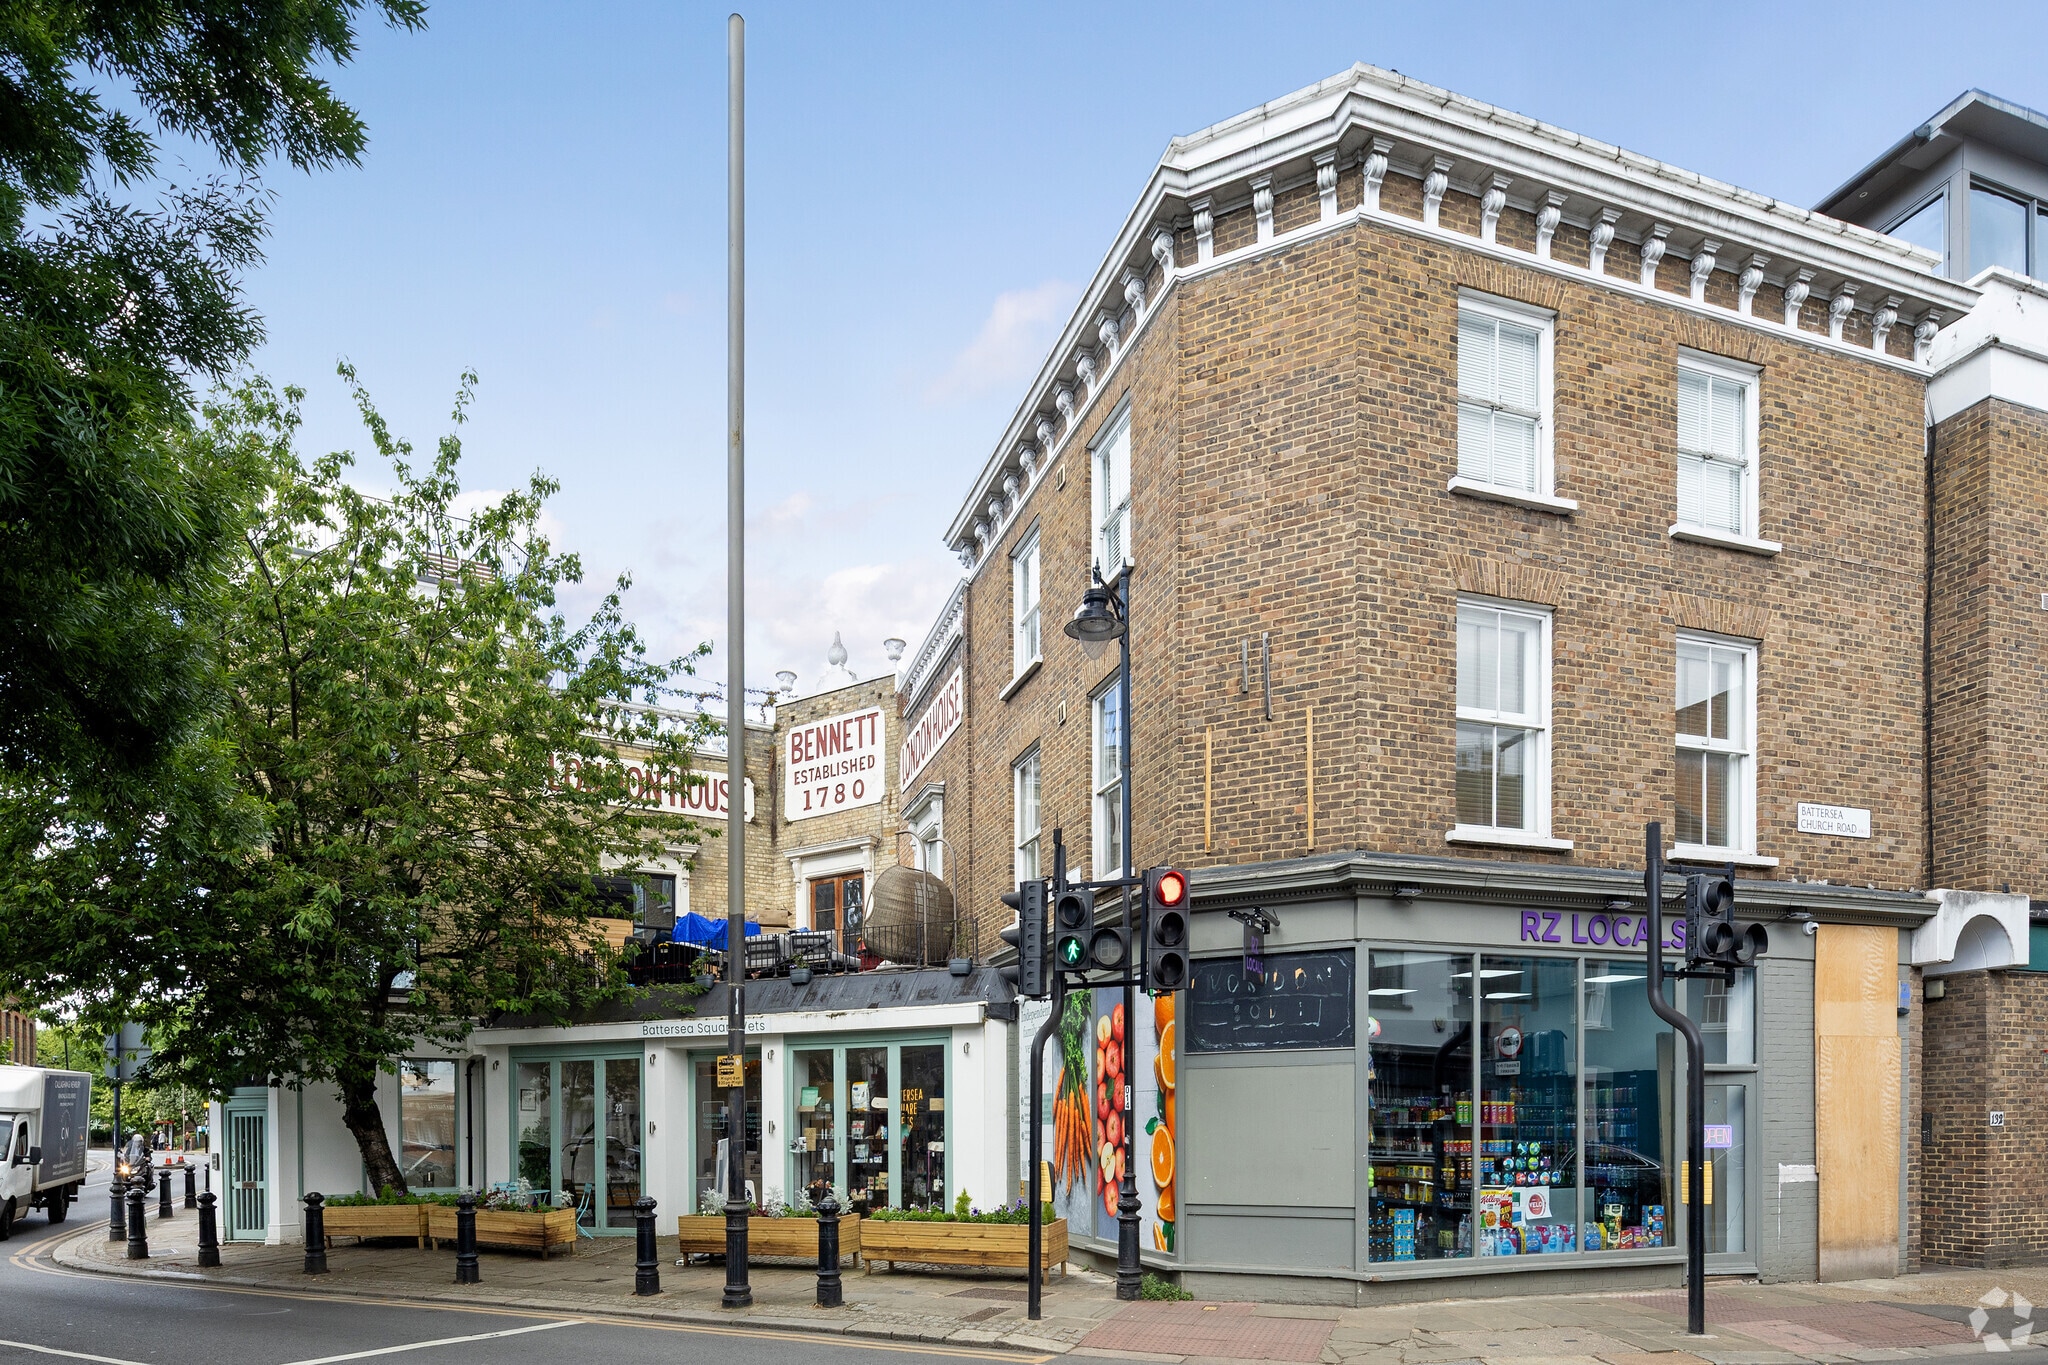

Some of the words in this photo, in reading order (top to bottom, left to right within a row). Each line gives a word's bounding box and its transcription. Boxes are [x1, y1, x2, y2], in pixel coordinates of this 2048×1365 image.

[791, 711, 879, 765] BENNETT
[902, 711, 932, 786] LONDON
[932, 674, 960, 749] HOUSE
[793, 754, 876, 786] ESTABLISHED
[549, 752, 662, 803] LOON
[669, 768, 747, 816] HOUS
[802, 778, 865, 812] 1780
[1801, 805, 1844, 820] BATTERSEA
[1800, 818, 1834, 832] CHURCH
[1836, 822, 1858, 834] ROAD
[1521, 910, 1562, 943] RZ
[1572, 913, 1687, 949] LOCAS
[1250, 935, 1259, 955] RZ
[1246, 956, 1264, 975] LOCALS
[642, 1024, 694, 1036] Battersea
[697, 1022, 728, 1035] Squar
[745, 1020, 766, 1032] ets
[900, 1088, 923, 1101] ERSEA
[614, 1103, 623, 1113] 23
